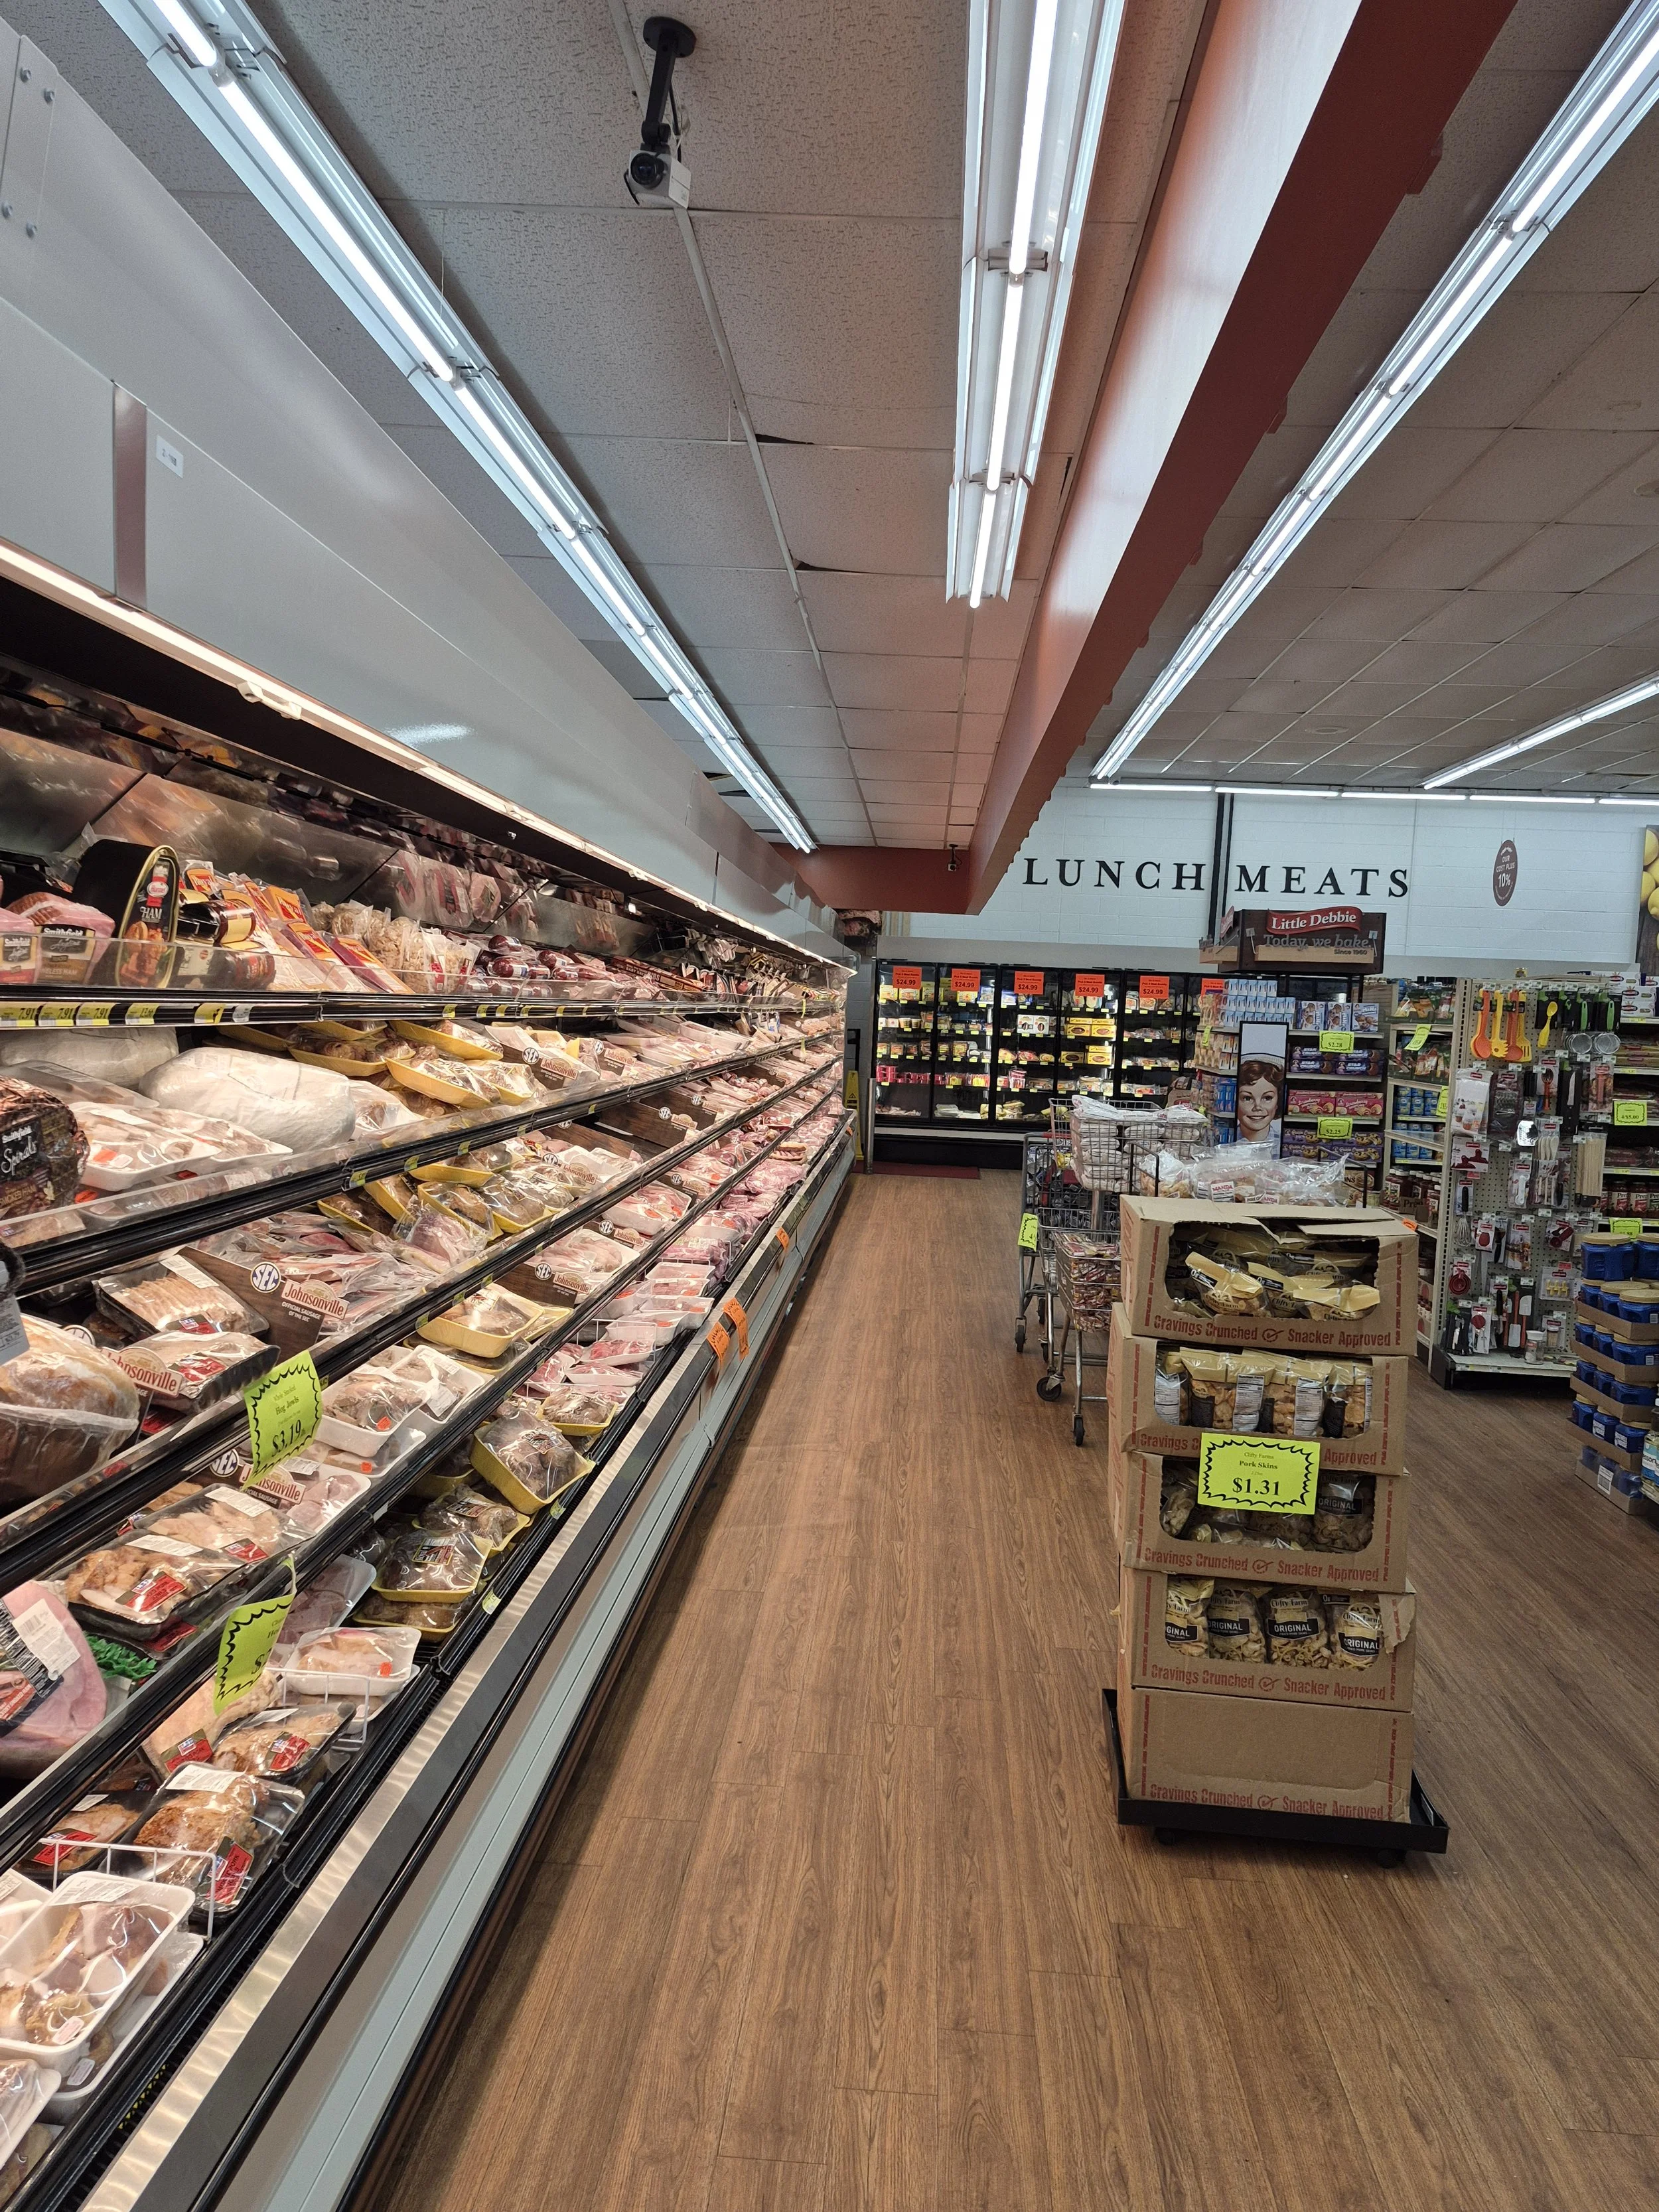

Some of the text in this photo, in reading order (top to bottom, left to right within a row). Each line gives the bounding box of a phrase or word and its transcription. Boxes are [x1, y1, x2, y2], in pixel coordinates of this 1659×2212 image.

[1496, 864, 1506, 873] COST
[1023, 858, 1408, 898] LUNCH MEATS
[1498, 873, 1511, 888] 10%
[140, 907, 163, 920] HAM
[1271, 911, 1357, 930] Little Debbie
[44, 928, 84, 939] Smithfield
[5, 937, 31, 946] Smithfield
[1263, 934, 1372, 952] Today, we bake.
[19, 1007, 36, 1020] 7.91
[57, 1007, 74, 1020] 7.91
[93, 1007, 109, 1020] 7.91
[524, 1048, 539, 1063] SEC
[606, 1050, 634, 1065] Johnsonville
[542, 1061, 577, 1078] Johnsonville
[563, 1165, 596, 1183] Johnsonville
[600, 1220, 613, 1233] SEC
[616, 1230, 644, 1245] Johnsonville
[253, 1264, 279, 1291] SEC
[536, 1264, 551, 1279] SEC
[555, 1274, 589, 1293] Johnsonville
[285, 1282, 344, 1316] Johnsonville
[281, 1301, 322, 1320] OFFICIAL SAUSAGE
[1153, 1315, 1391, 1349] Cravings Crunched Snacker Approved
[275, 1395, 300, 1416] Hog Jowls
[271, 1419, 302, 1457] $3.19
[1140, 1433, 1189, 1450] Cravings
[1324, 1447, 1377, 1466] Approved
[1258, 1461, 1278, 1469] Skins
[243, 1466, 301, 1501] Jnsonville
[1232, 1477, 1280, 1497] $1.31
[258, 1493, 278, 1505] SAUSAGE
[1319, 1498, 1356, 1511] ORIGINAL
[1144, 1547, 1379, 1582] Cravings Crunched Snacker Approved
[1173, 1603, 1189, 1613] Farm
[1167, 1627, 1190, 1637] GINAL
[1274, 1624, 1312, 1633] ORIGINAL
[1344, 1638, 1380, 1650] ORIGINAL
[1151, 1664, 1386, 1700] Cravings Crunched Snacker Approved
[1150, 1783, 1384, 1819] Cravings Crunched Snacker Approved
